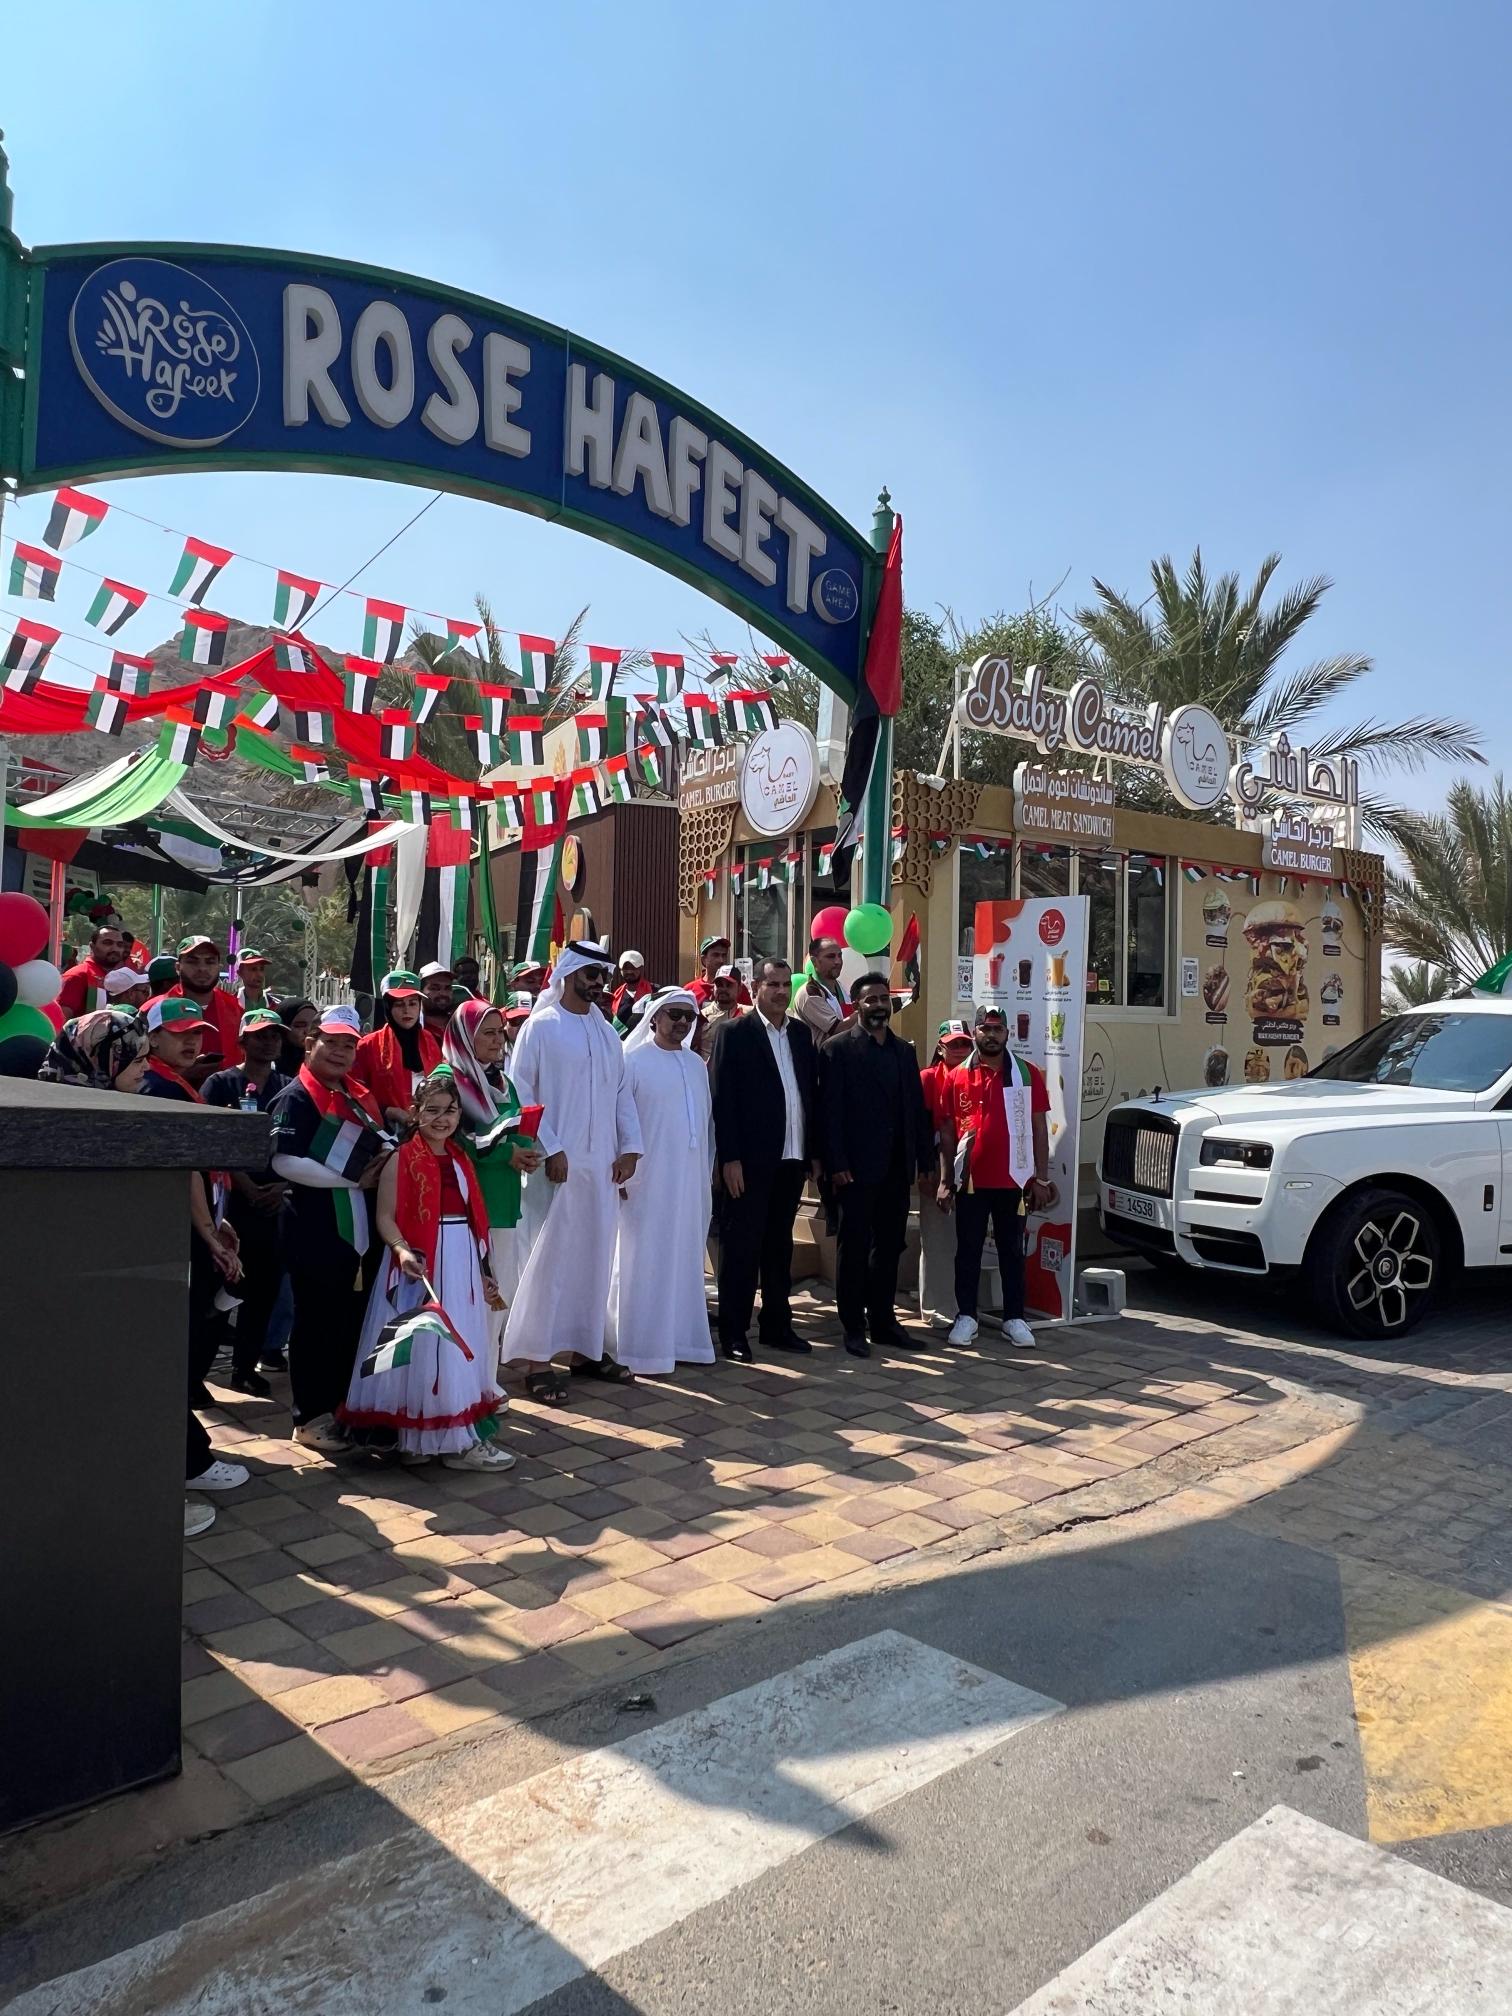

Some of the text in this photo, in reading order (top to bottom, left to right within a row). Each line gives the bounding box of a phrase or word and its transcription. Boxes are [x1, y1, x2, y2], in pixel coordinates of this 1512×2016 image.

[136, 298, 240, 367] Rose
[97, 295, 238, 418] Hafeet
[284, 283, 827, 615] ROSE HAFEET
[825, 579, 850, 597] GAME
[967, 654, 1168, 761] Baby Camel
[1189, 761, 1218, 777] CAMEL
[1236, 731, 1358, 820] الحاشي
[680, 780, 737, 810] CAMEL BURGER
[764, 780, 799, 796] CAMEL
[1022, 804, 1112, 838] CAMEL MEAT SANDWICH
[1271, 848, 1332, 873] CAMEL BURGER
[1127, 1197, 1153, 1217] 14538
